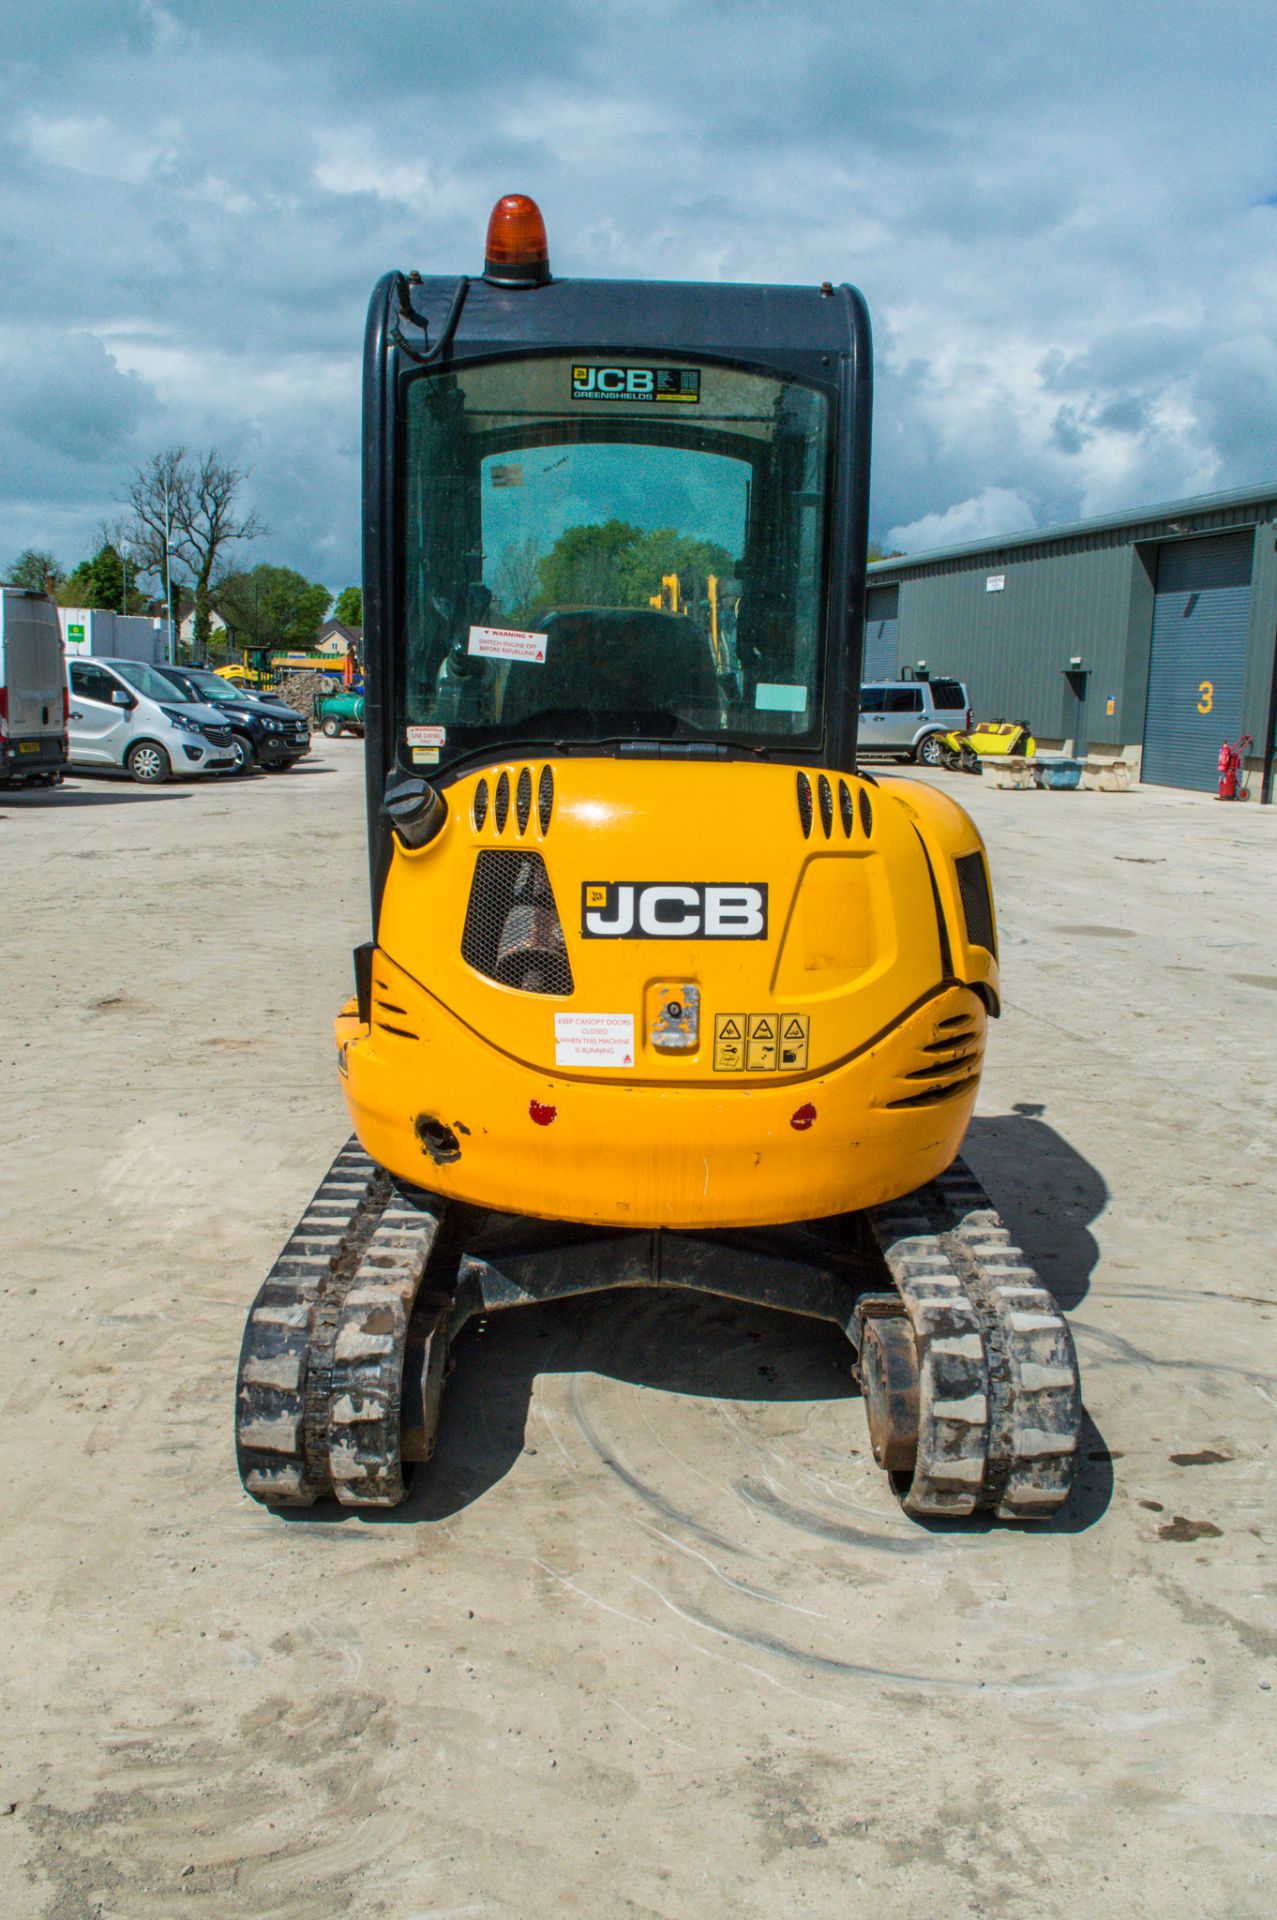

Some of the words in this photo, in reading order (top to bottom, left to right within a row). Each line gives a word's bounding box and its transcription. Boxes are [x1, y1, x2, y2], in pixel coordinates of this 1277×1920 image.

[573, 368, 654, 392] JCB
[573, 391, 653, 400] GREENSHIELDS
[502, 648, 535, 656] REFUELLING
[1197, 681, 1213, 713] 3
[586, 886, 764, 936] JCB
